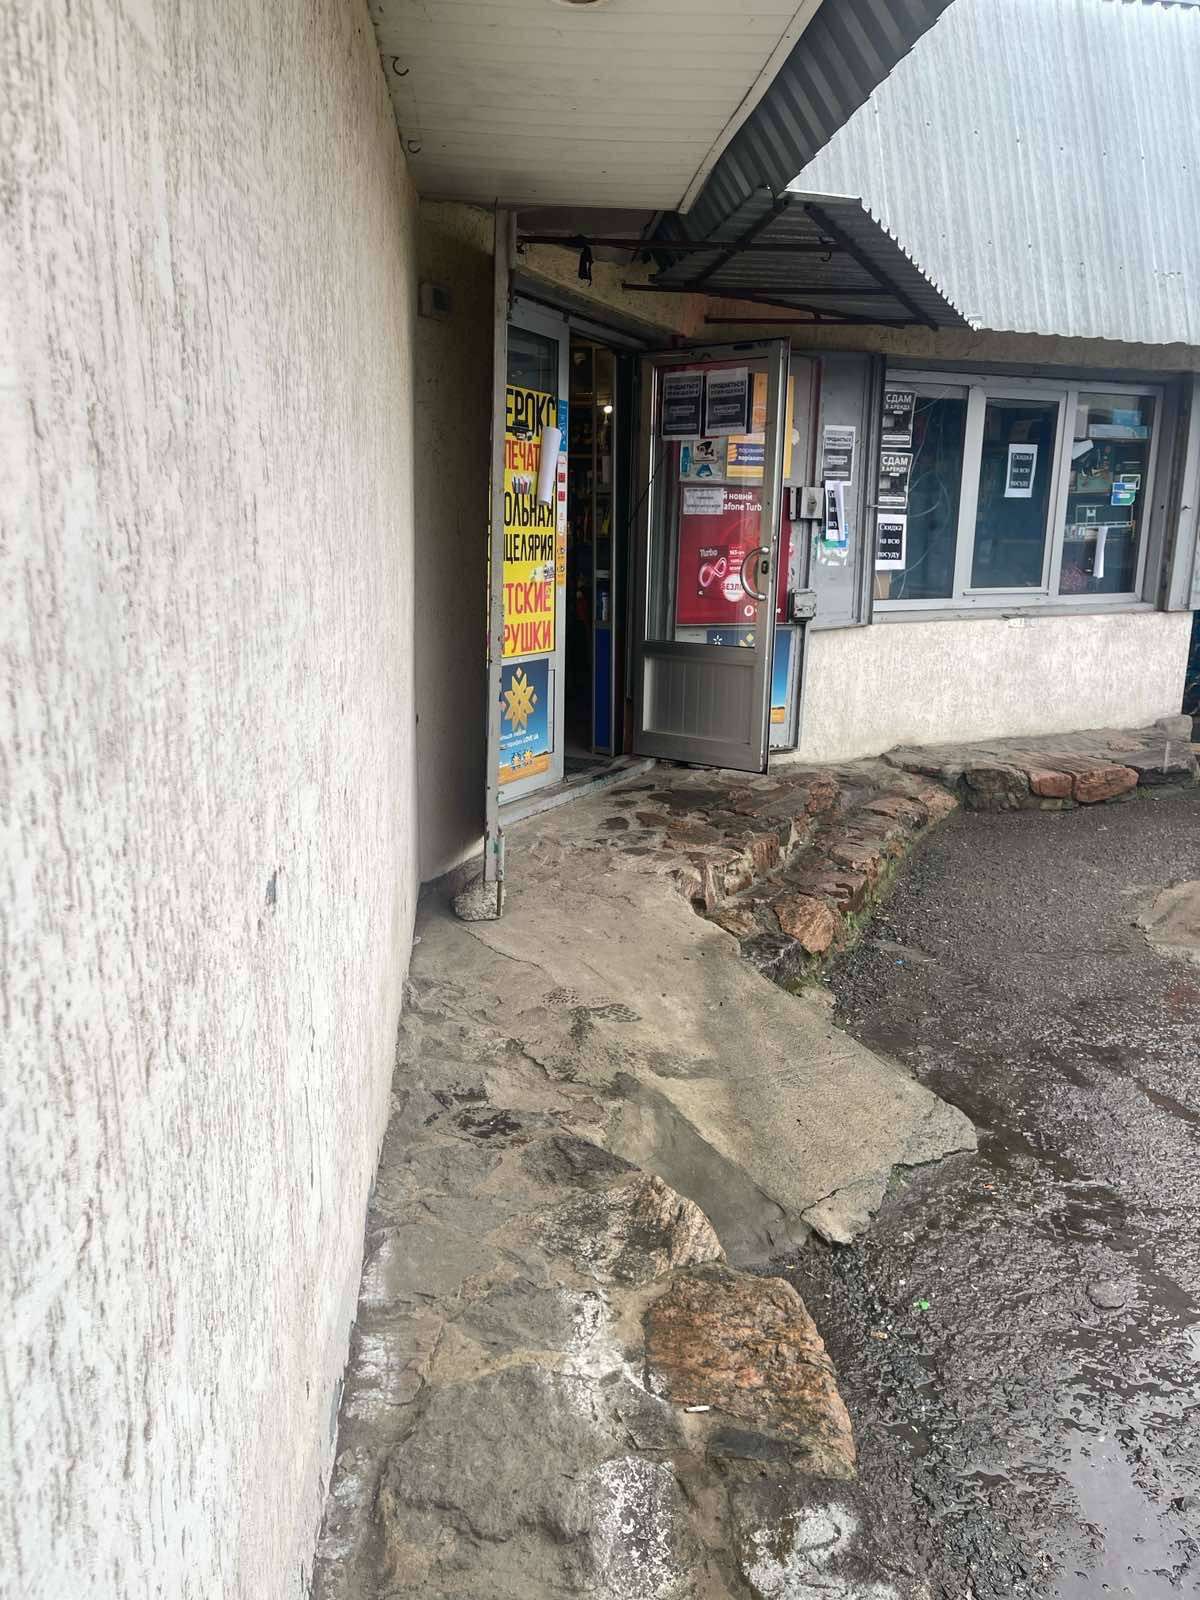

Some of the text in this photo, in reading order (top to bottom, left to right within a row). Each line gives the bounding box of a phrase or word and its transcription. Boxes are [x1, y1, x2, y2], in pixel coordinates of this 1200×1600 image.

[886, 394, 912, 403] СДАМ
[505, 439, 541, 474] ПЕЧАТ
[882, 456, 908, 465] СДАМ
[729, 492, 753, 500] новий
[503, 534, 553, 564] ЦЕЛЯРИЯ
[503, 582, 551, 616] ТСКИЕ
